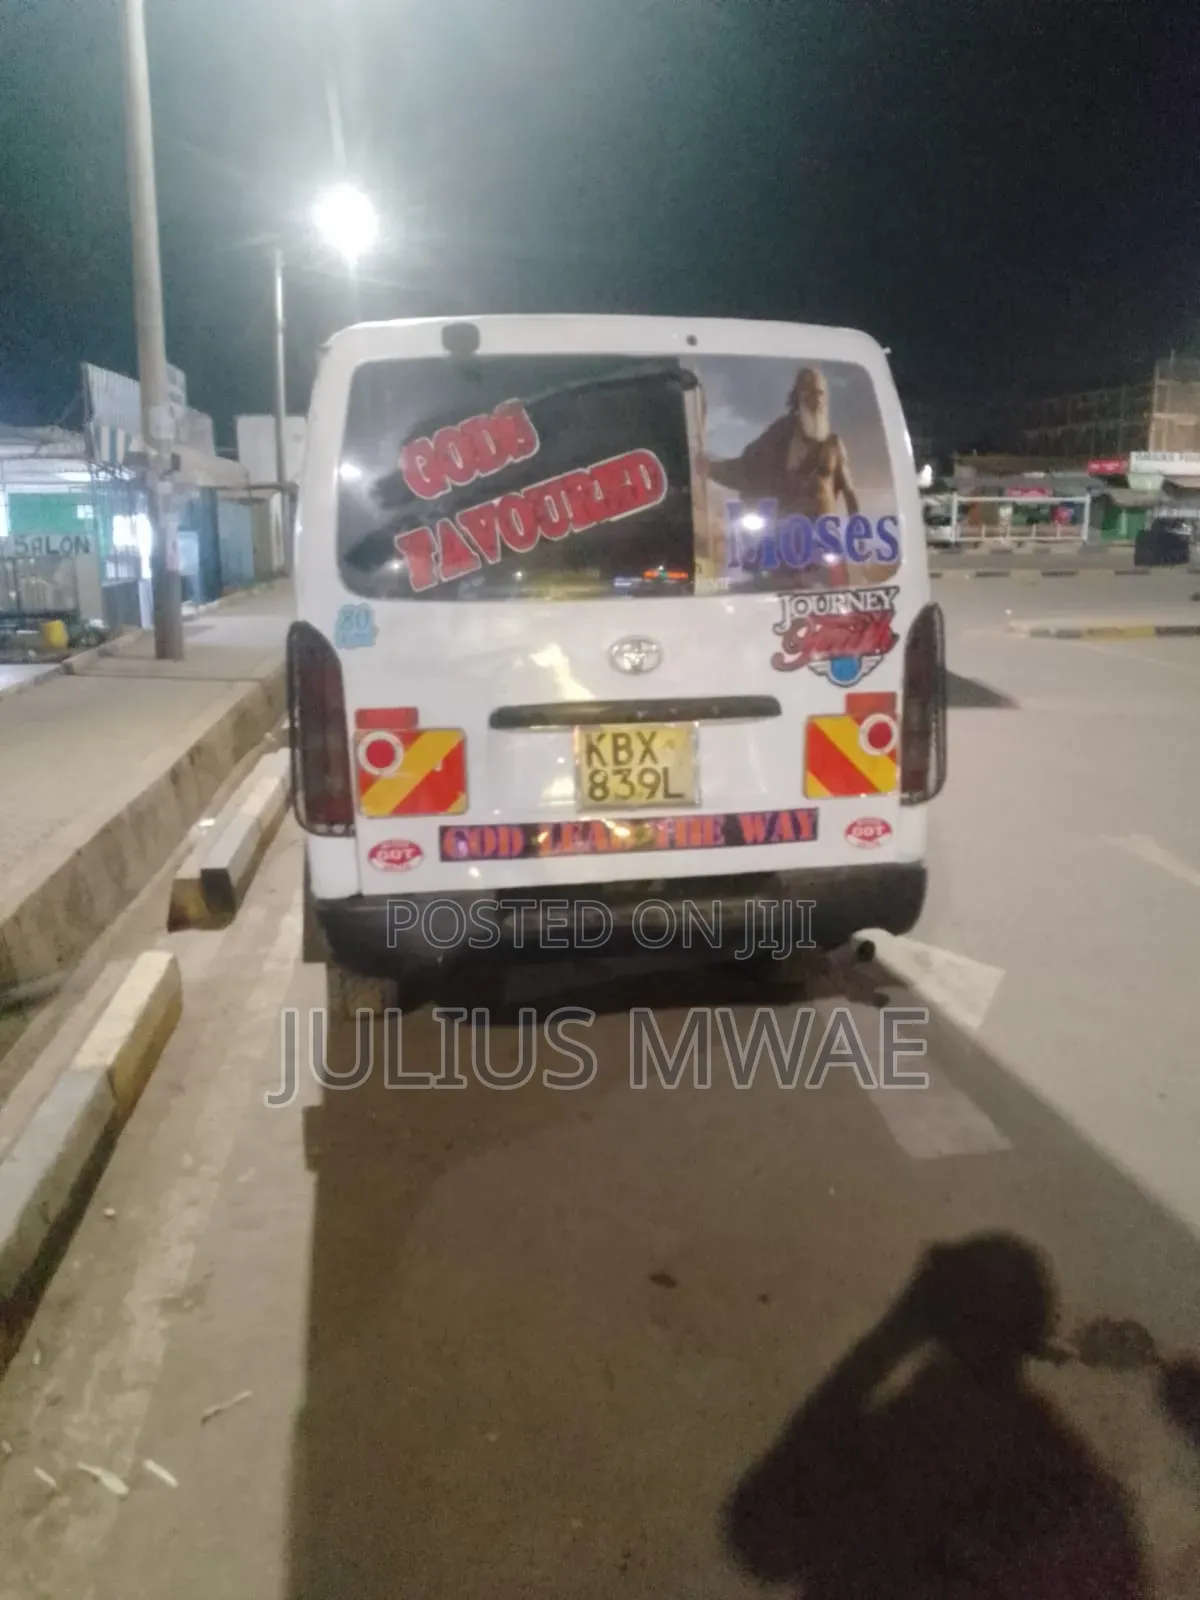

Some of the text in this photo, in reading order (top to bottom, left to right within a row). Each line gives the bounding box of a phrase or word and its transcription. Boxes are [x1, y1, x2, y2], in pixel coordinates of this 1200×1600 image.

[14, 535, 89, 555] SALON
[726, 498, 900, 569] Moses
[772, 586, 900, 636] JOURNEY
[585, 731, 658, 768] KBX
[588, 767, 685, 802] 839L
[442, 824, 524, 858] GOD
[648, 813, 724, 850] THE
[738, 809, 818, 845] WAY
